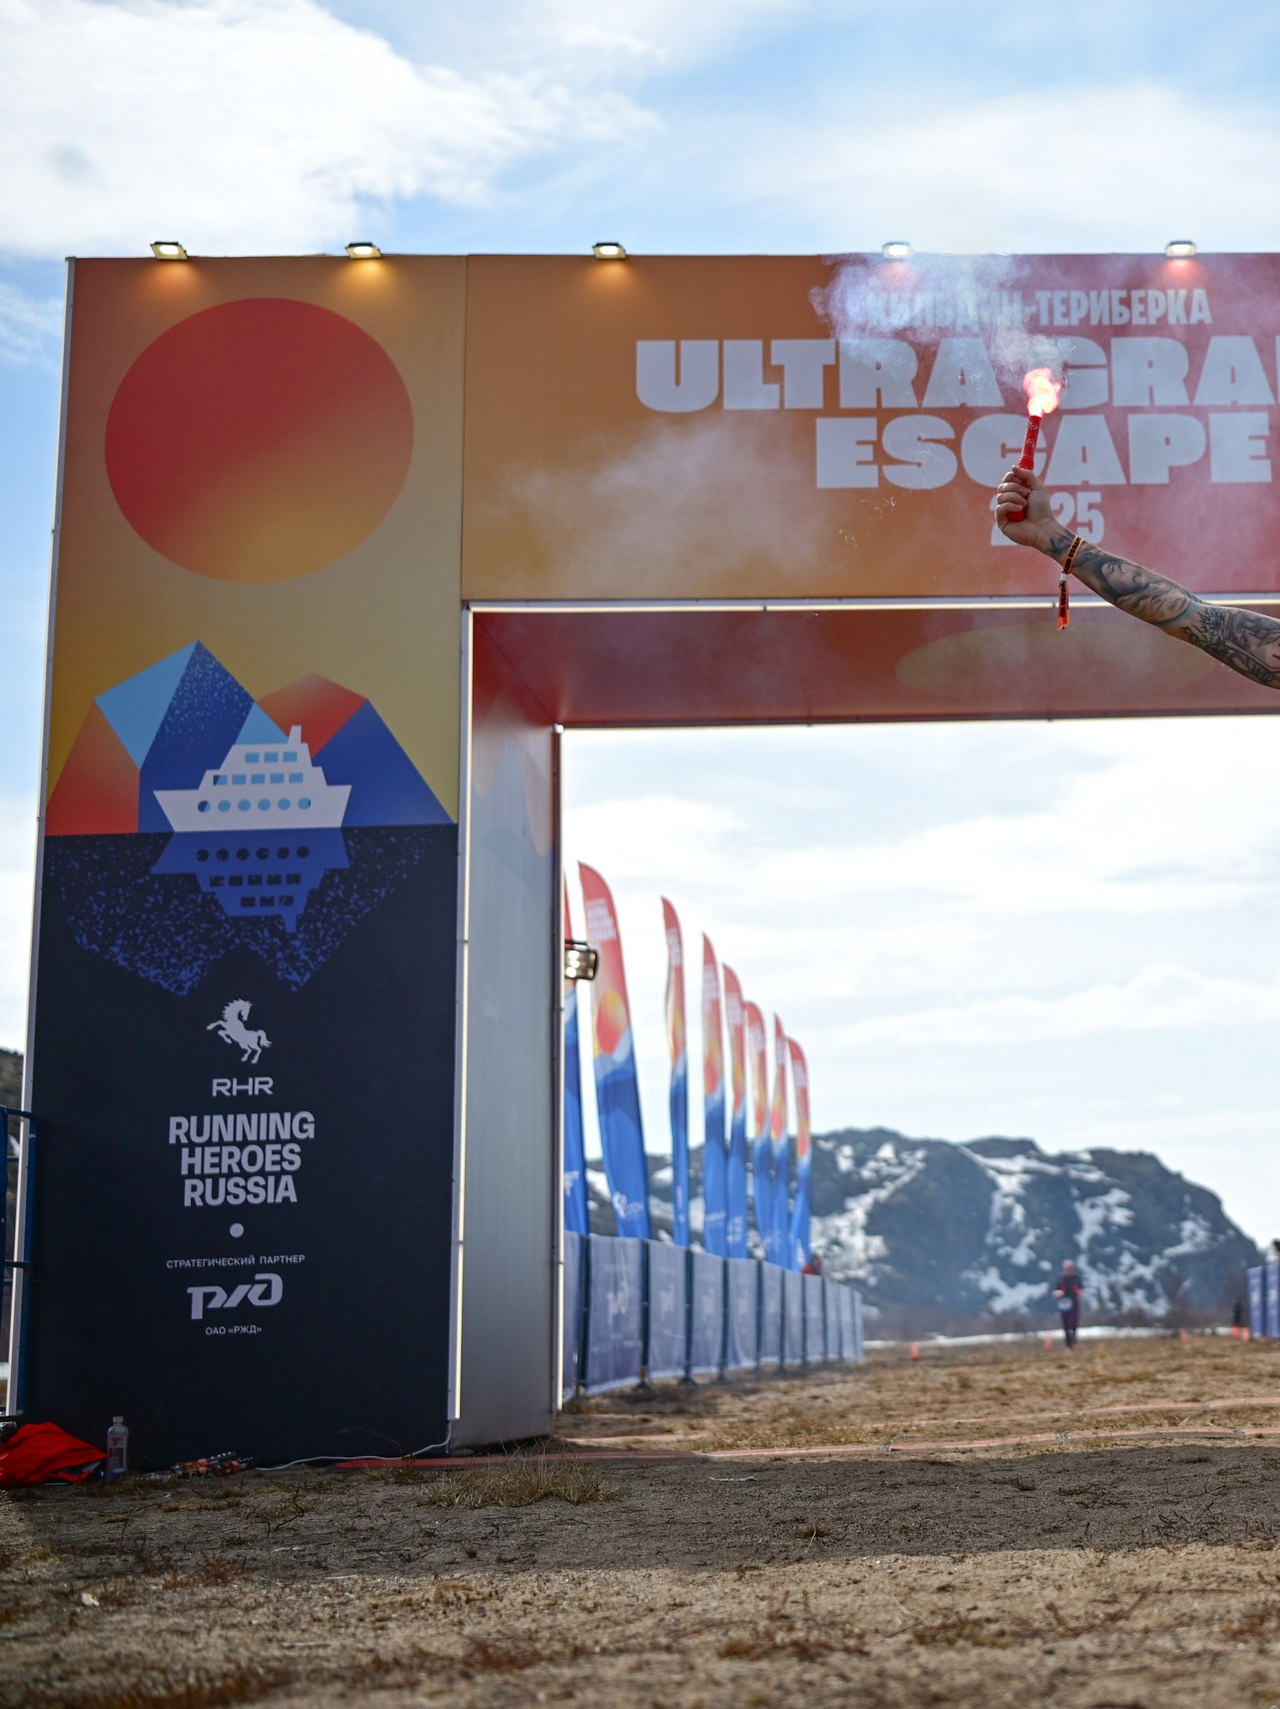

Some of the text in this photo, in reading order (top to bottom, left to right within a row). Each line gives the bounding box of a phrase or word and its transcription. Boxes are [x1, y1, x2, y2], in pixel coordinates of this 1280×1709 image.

[636, 337, 1006, 414] ULTRA
[815, 411, 1273, 490] ESCAPE
[211, 1076, 275, 1098] RHR
[168, 1110, 316, 1145] RUNNING
[180, 1142, 302, 1176] HEROES
[183, 1174, 298, 1208] RUSSIA
[166, 1254, 306, 1269] СТРАТЕГИЧЕСКИЙ ПАРТНЕР
[205, 1326, 227, 1336] ОАО
